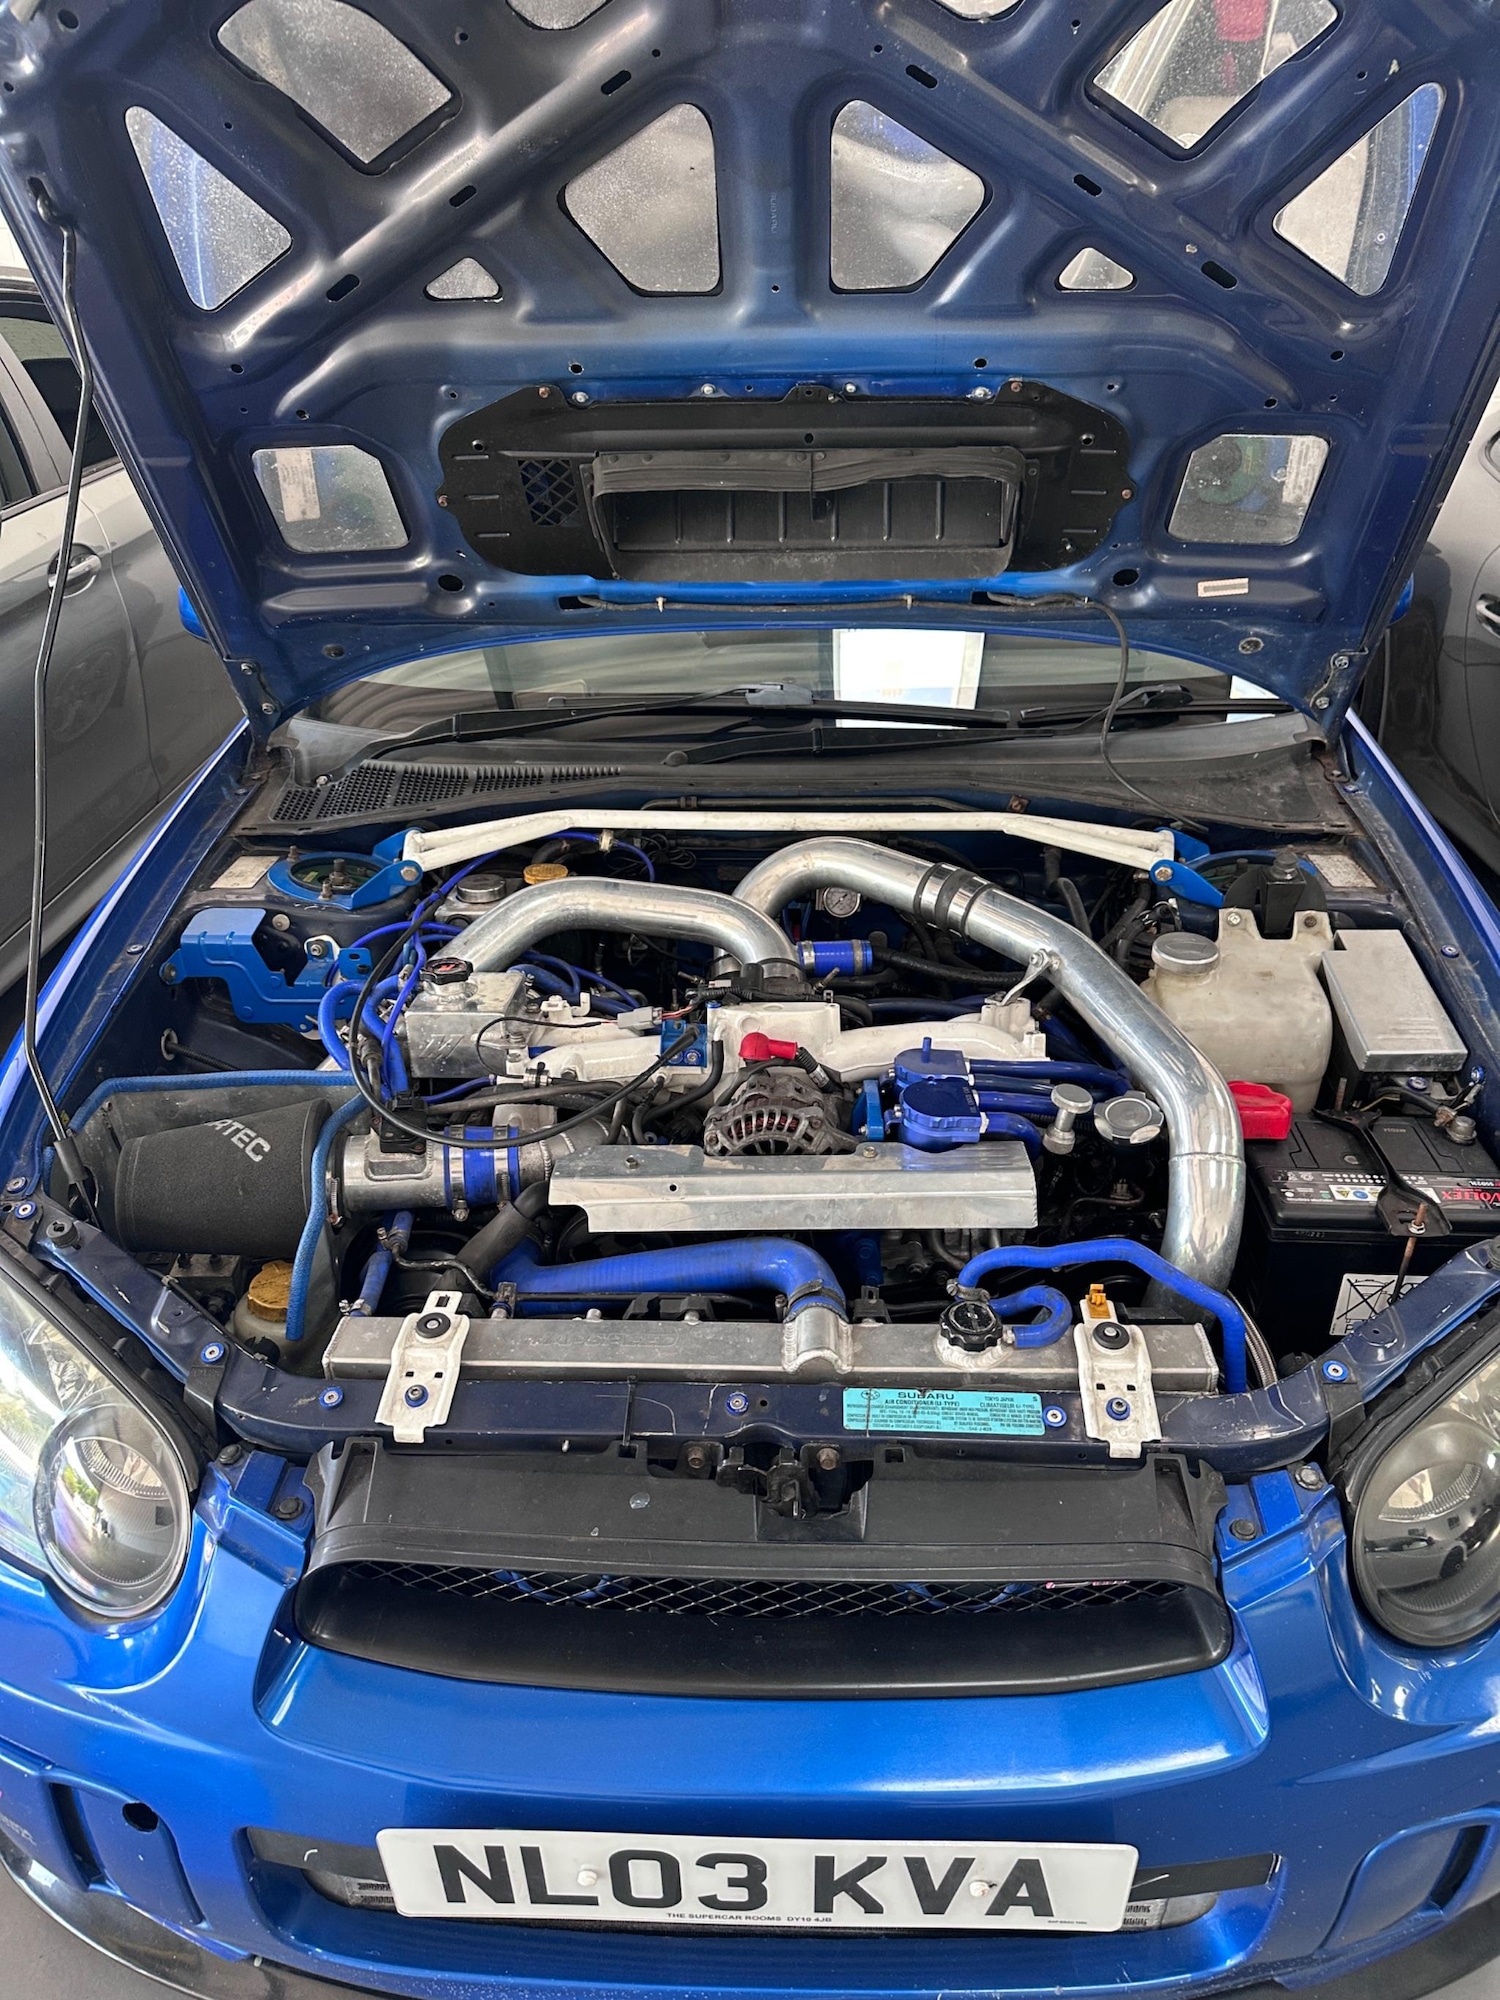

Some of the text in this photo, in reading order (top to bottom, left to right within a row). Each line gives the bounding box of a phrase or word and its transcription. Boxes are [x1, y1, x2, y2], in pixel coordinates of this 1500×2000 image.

[897, 1391, 955, 1400] SUBARU
[434, 1846, 1053, 1916] NL03 KVA
